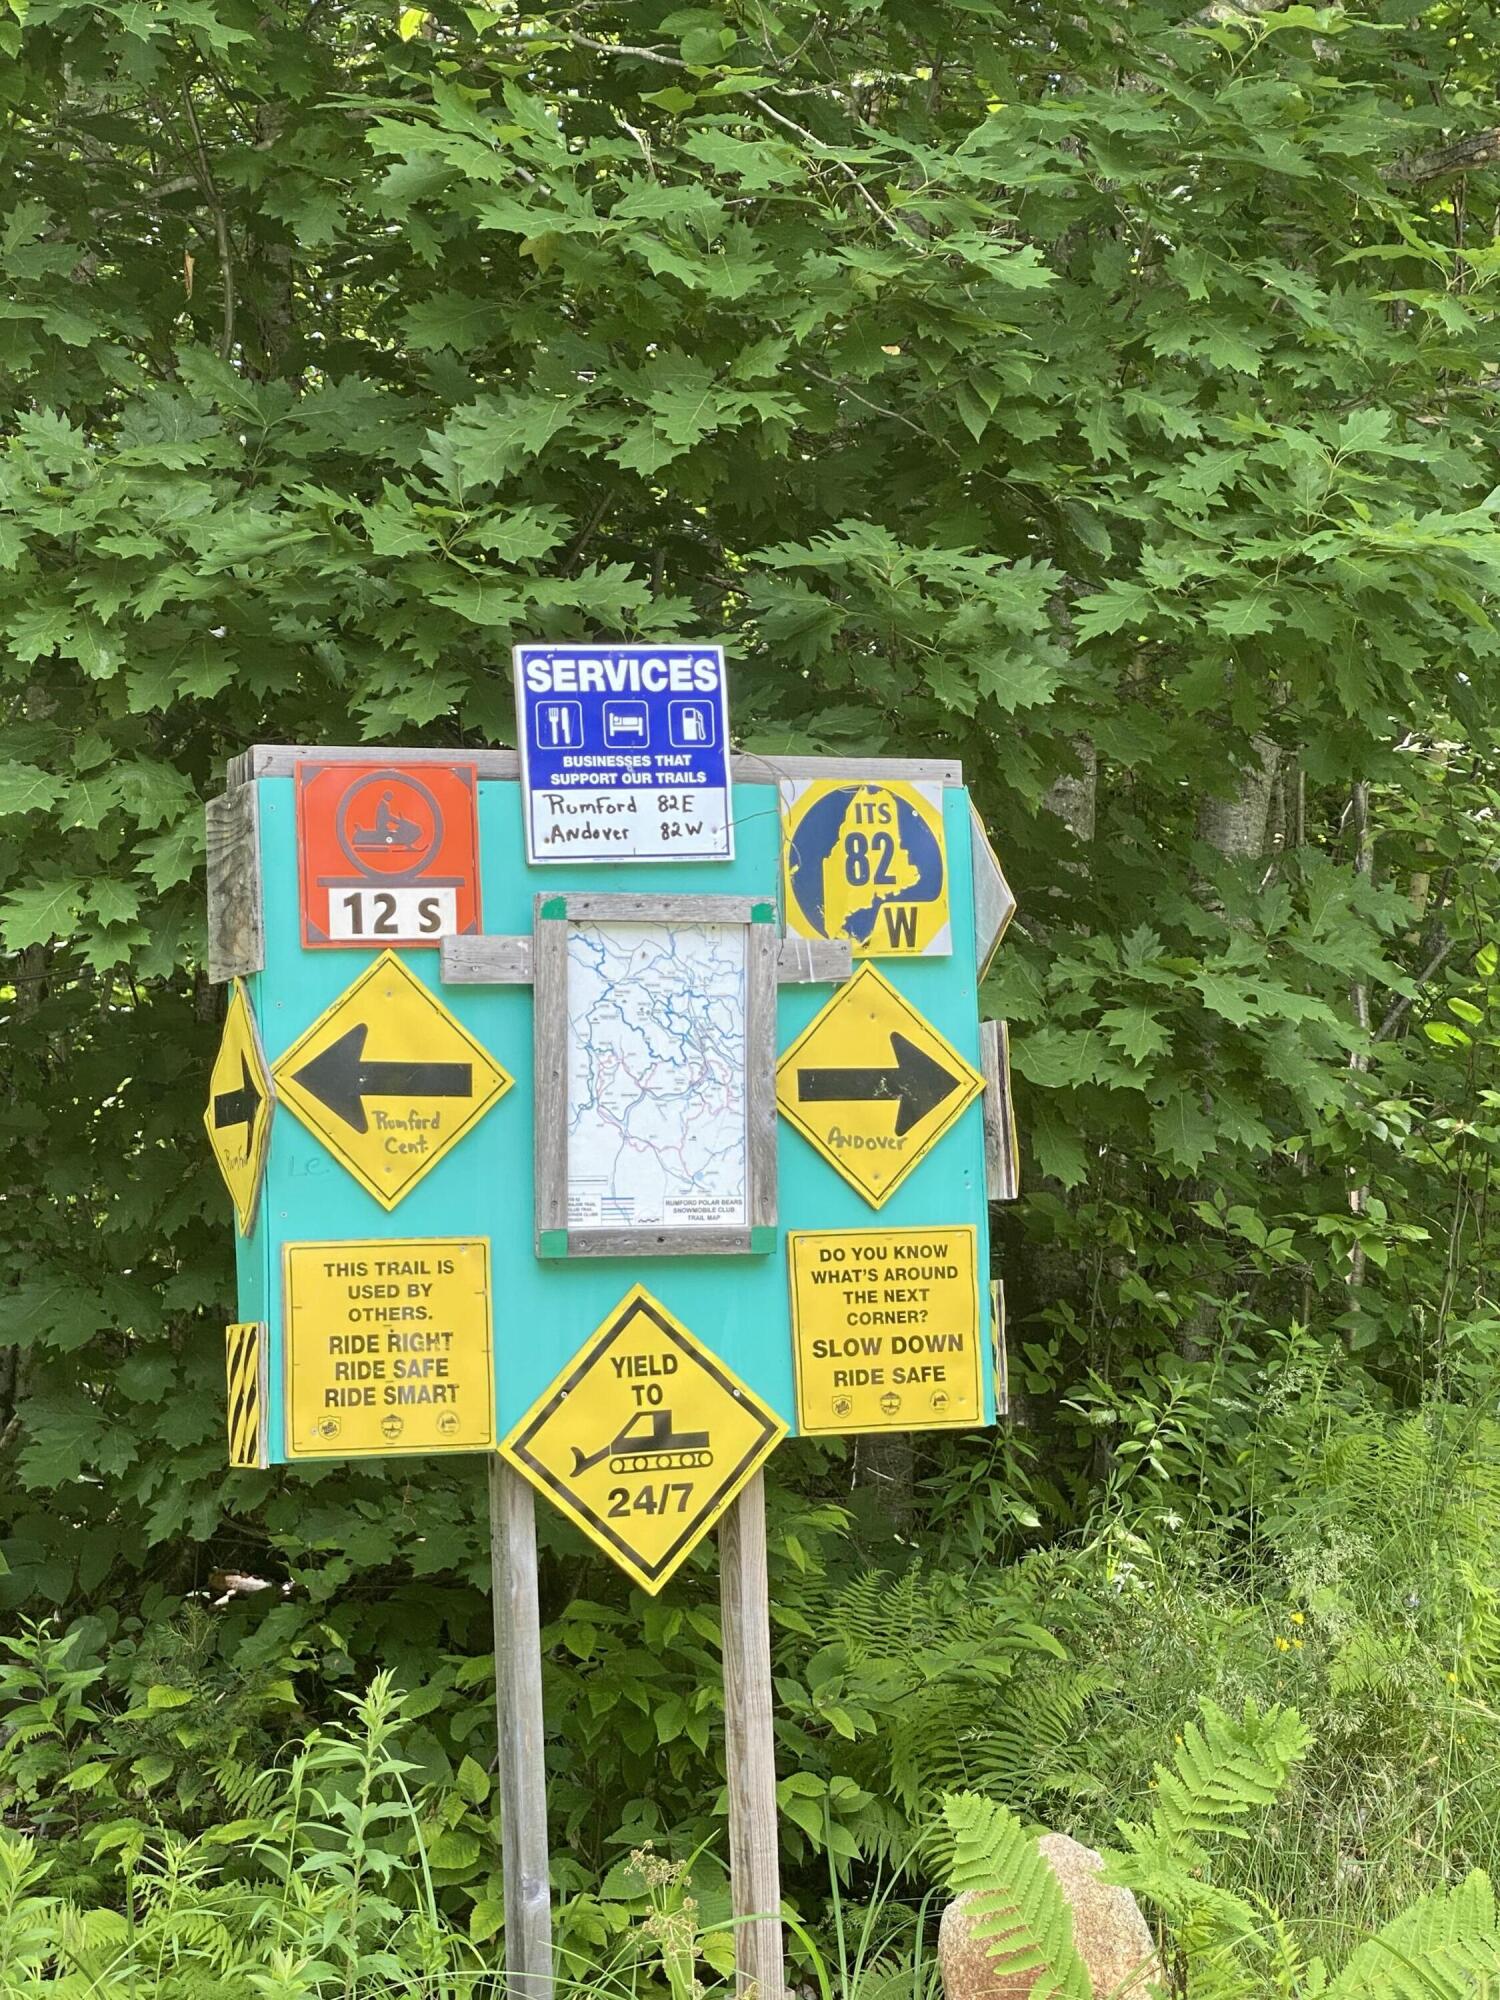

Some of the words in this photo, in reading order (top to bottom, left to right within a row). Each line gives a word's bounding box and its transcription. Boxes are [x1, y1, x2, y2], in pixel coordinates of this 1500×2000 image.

[527, 658, 718, 693] SERVICES
[563, 755, 651, 767] BUSINESSES
[655, 755, 692, 766] THAT
[551, 773, 618, 785] SUPPORT
[622, 773, 652, 784] OUR
[656, 772, 707, 783] TRAILS
[855, 803, 892, 824] ITS
[844, 831, 897, 887] 82
[343, 892, 399, 934] 12
[417, 897, 441, 933] S
[884, 907, 918, 948] W
[371, 1109, 441, 1130] Rumford
[819, 1247, 846, 1262] DO
[851, 1246, 887, 1261] YOU
[893, 1244, 948, 1260] KNOW
[324, 1262, 368, 1277] THIS
[374, 1260, 431, 1276] TRAIL
[437, 1259, 454, 1274] IS
[811, 1268, 879, 1284] WHAT'S
[883, 1265, 958, 1281] AROUND
[348, 1284, 400, 1300] USED
[407, 1283, 433, 1298] BY
[843, 1290, 878, 1304] THE
[884, 1288, 930, 1303] NEXT
[348, 1306, 433, 1322] OTHERS.
[846, 1309, 929, 1326] CORNER?
[329, 1334, 380, 1355] RIDE
[387, 1332, 453, 1352] RIGHT
[812, 1336, 883, 1359] SLOW
[891, 1333, 964, 1354] DOWN
[335, 1360, 385, 1381] RIDE
[393, 1358, 449, 1379] SAFE
[610, 1354, 678, 1378] YIELD
[833, 1367, 885, 1387] RIDE
[892, 1365, 946, 1384] SAFE
[324, 1387, 376, 1408] RIDE
[383, 1384, 460, 1406] SMART
[631, 1383, 663, 1406] TO
[607, 1482, 694, 1518] 24/7
